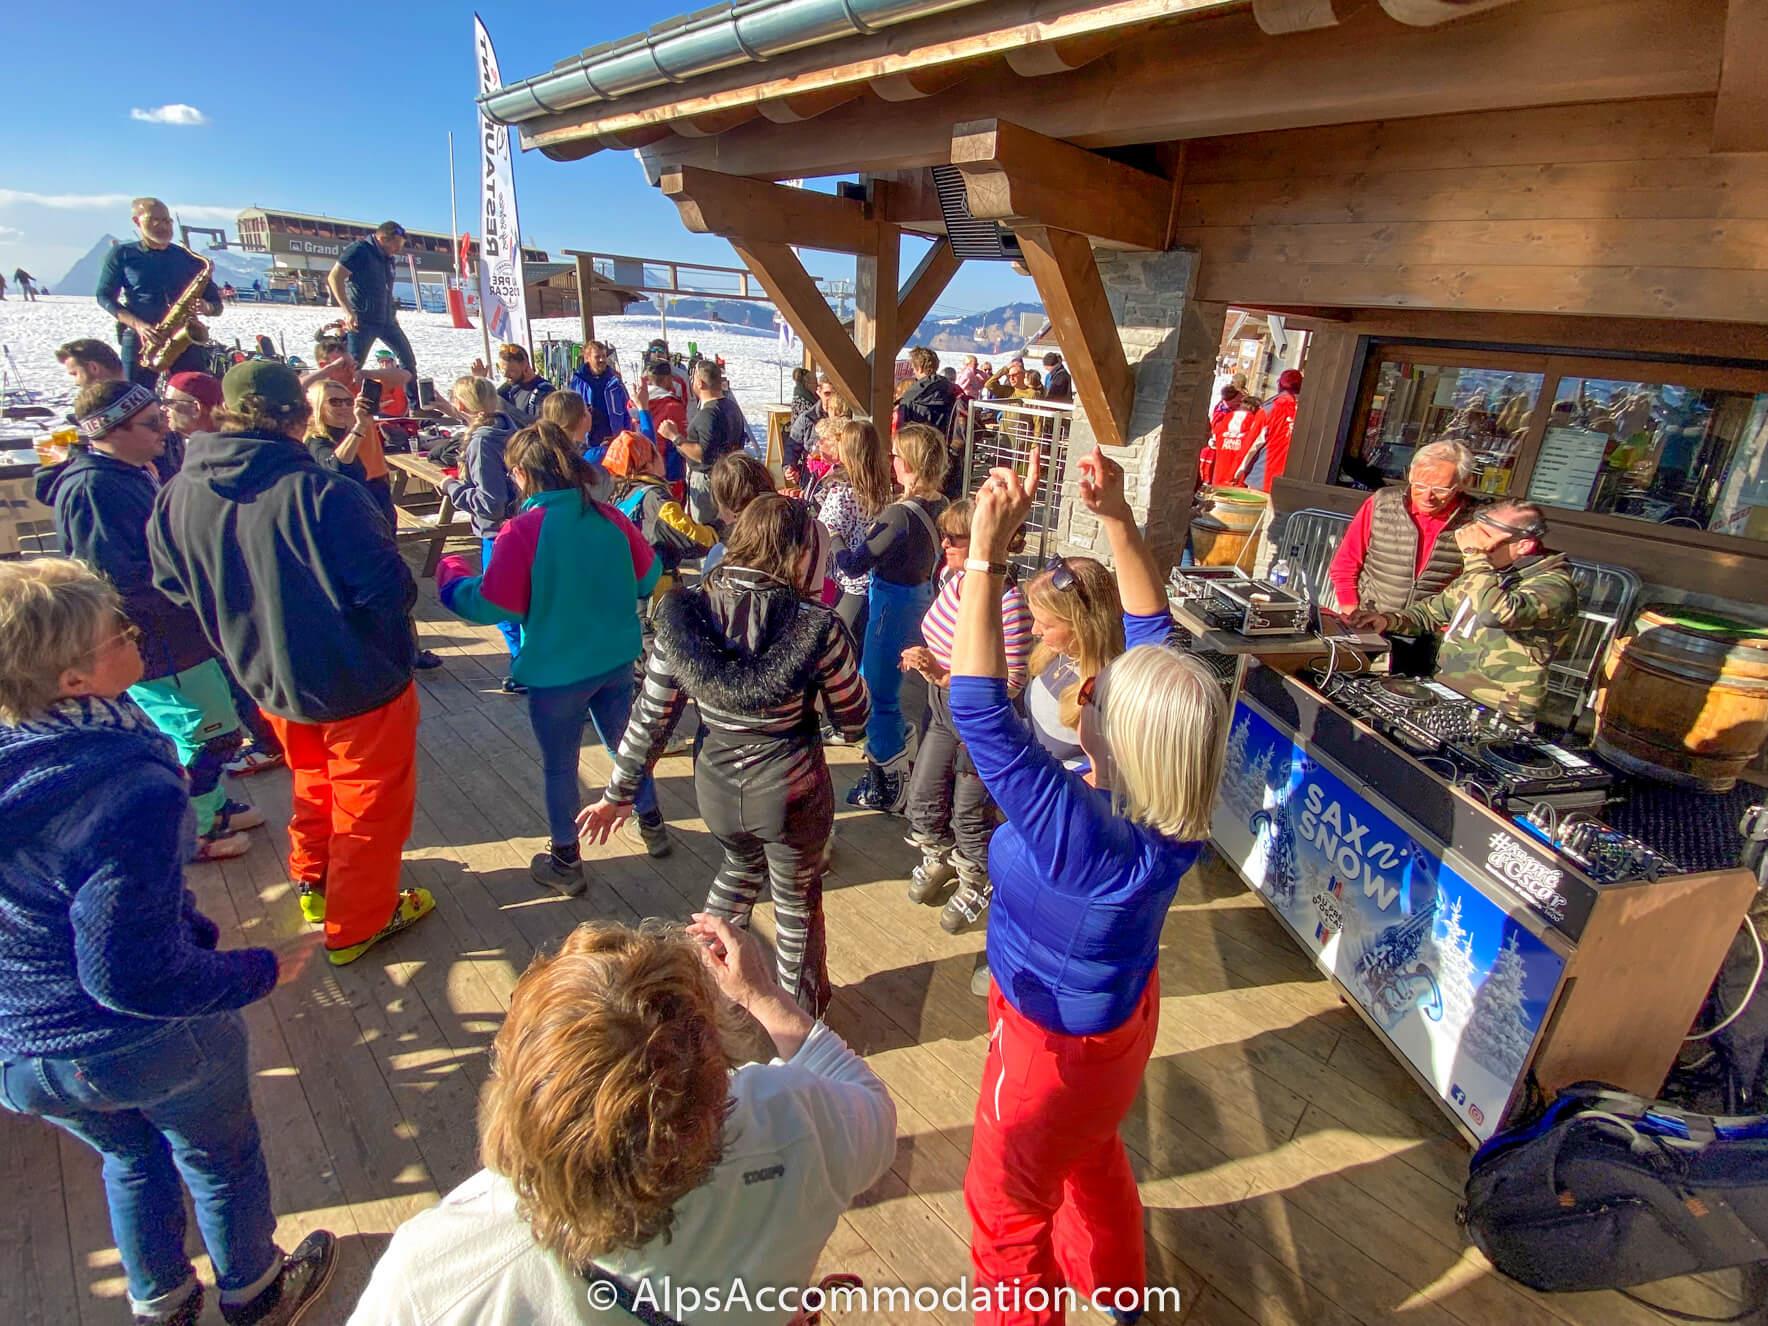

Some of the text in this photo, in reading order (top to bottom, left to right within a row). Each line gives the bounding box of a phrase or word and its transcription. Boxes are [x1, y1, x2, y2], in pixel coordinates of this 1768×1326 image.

[304, 241, 339, 256] Grand
[1304, 783, 1370, 857] SAX
[1298, 810, 1399, 912] SNOW
